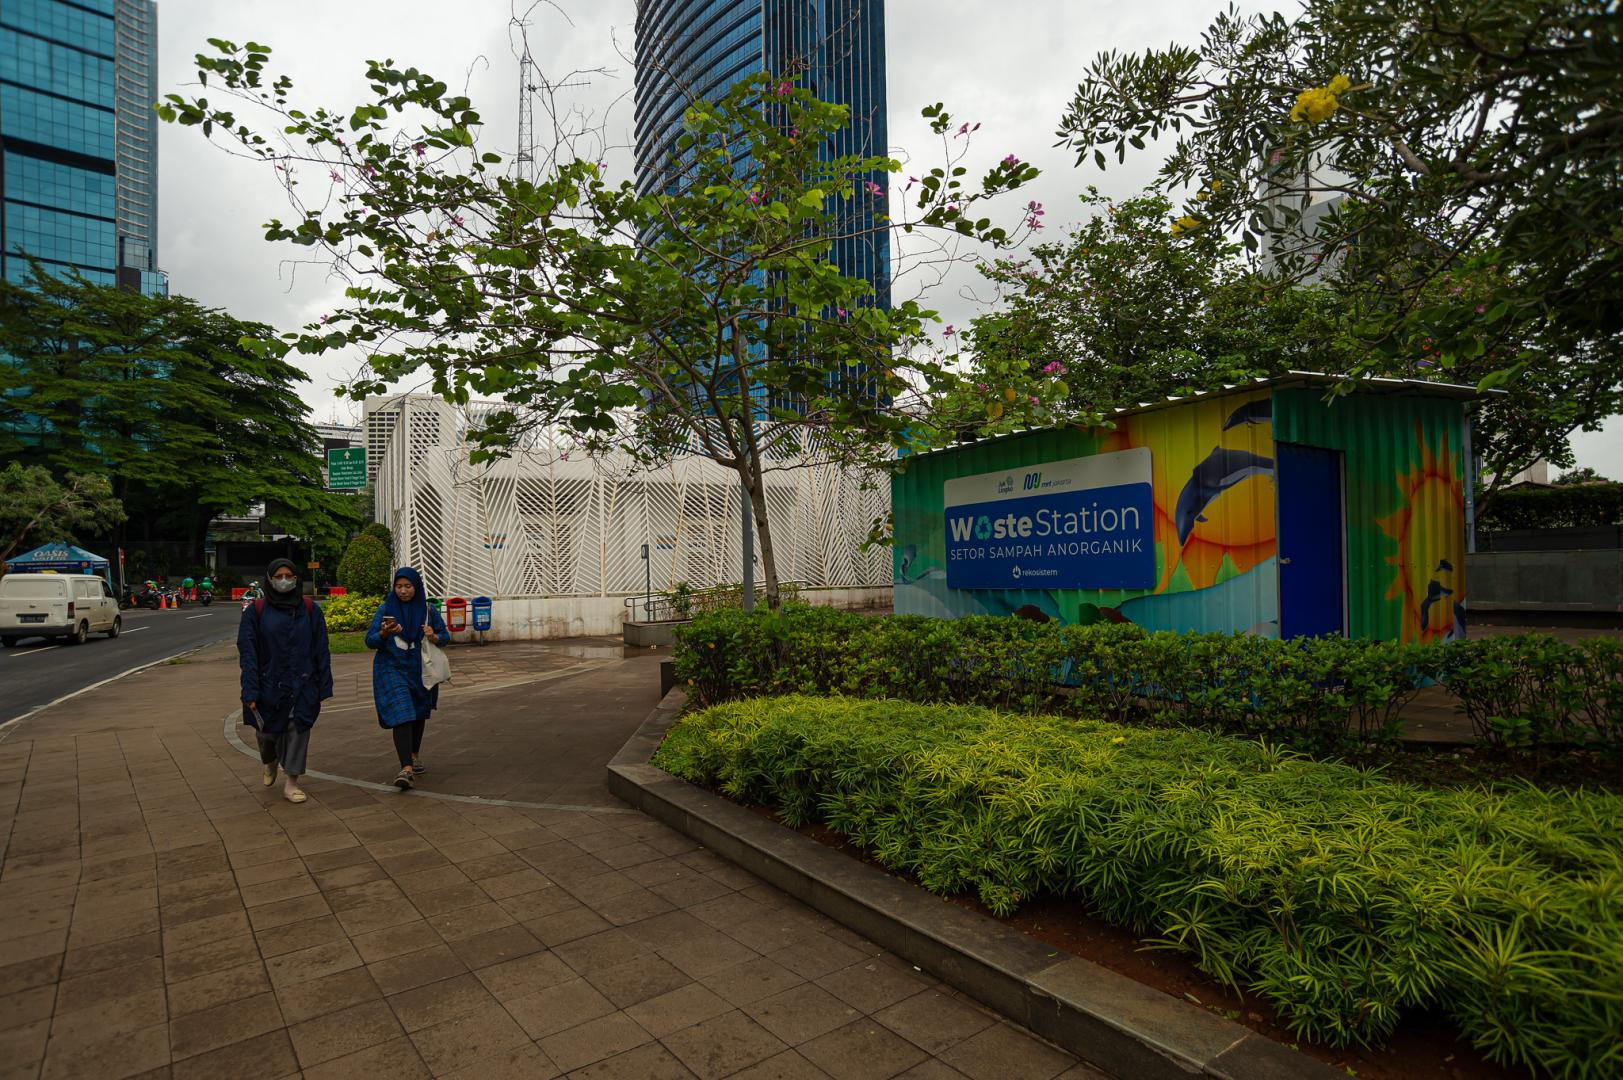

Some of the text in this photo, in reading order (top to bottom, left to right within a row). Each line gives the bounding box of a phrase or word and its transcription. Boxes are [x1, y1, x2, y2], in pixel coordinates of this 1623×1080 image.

[1036, 502, 1139, 536] Station
[950, 538, 1142, 560] SETOR SAMPAH ANORGANIK
[1022, 568, 1058, 577] rekosistem
